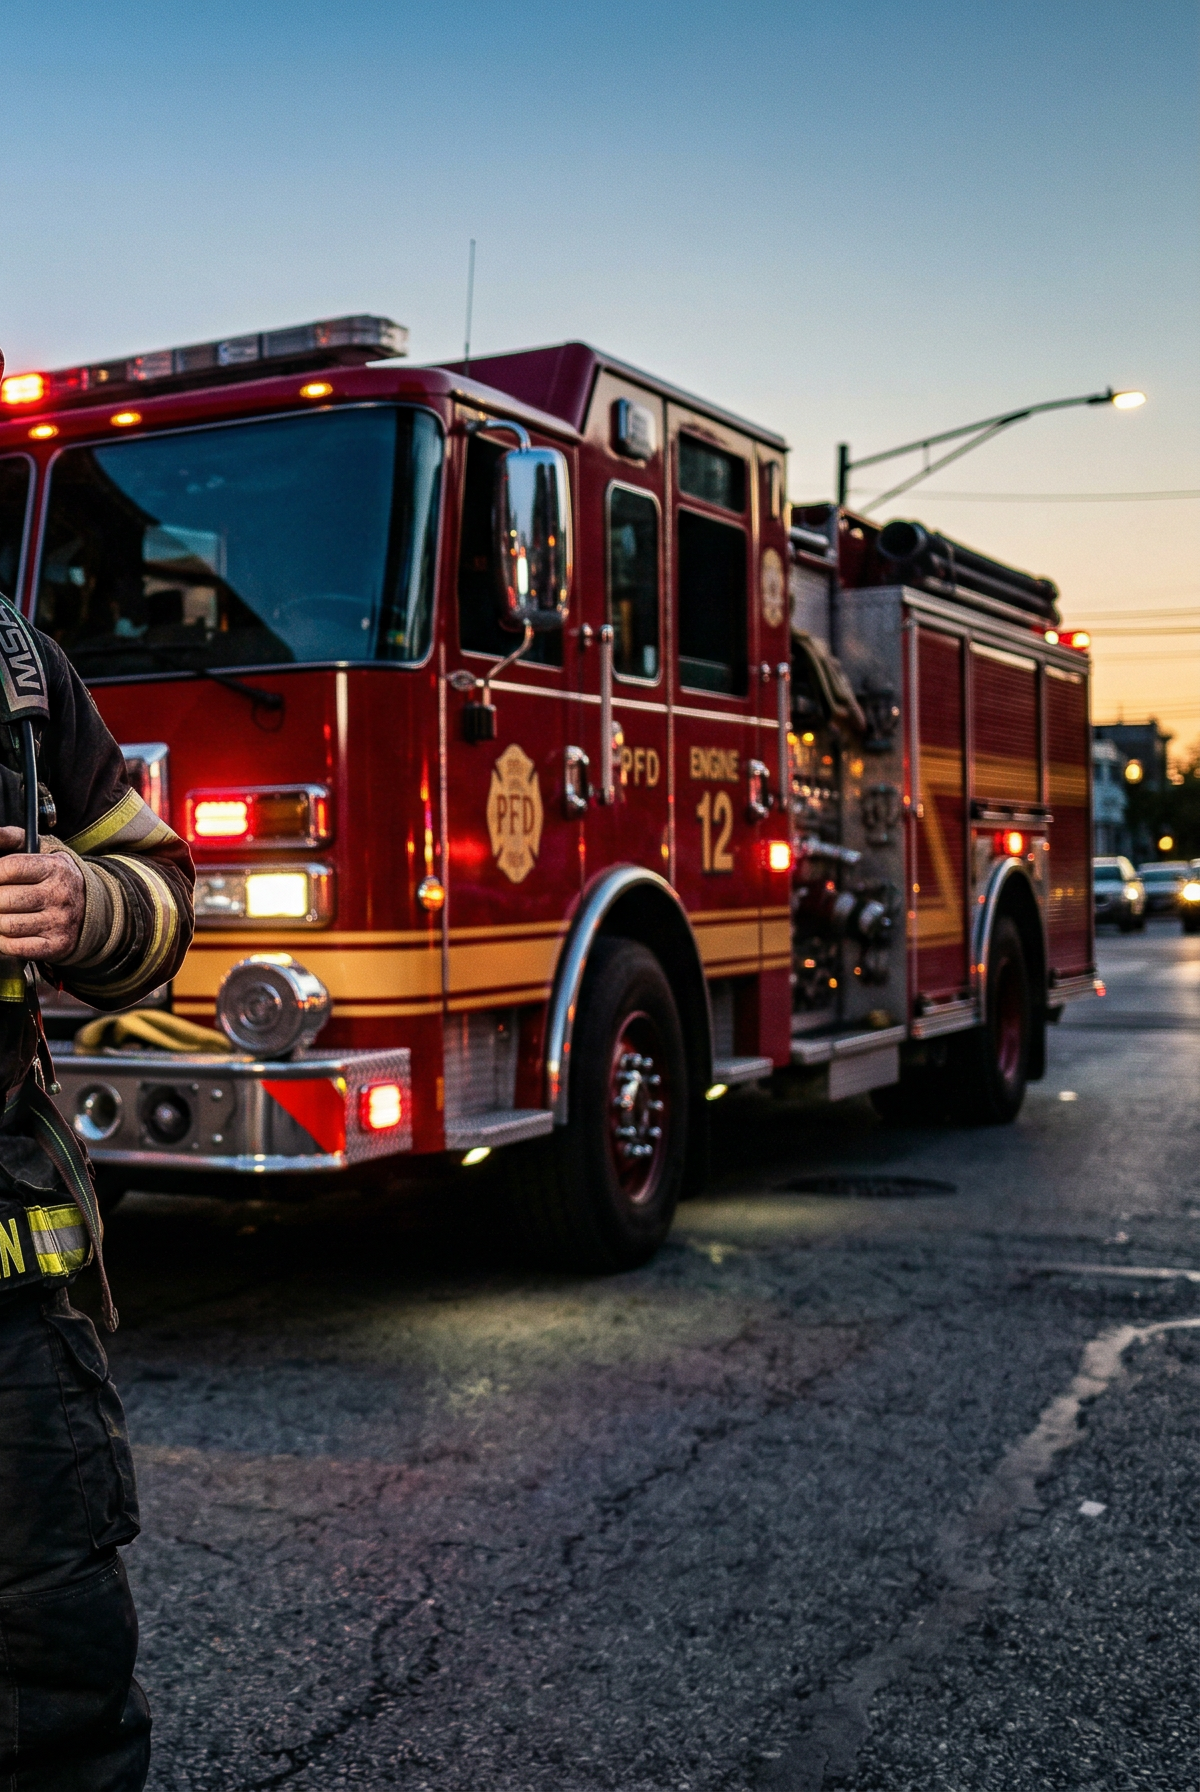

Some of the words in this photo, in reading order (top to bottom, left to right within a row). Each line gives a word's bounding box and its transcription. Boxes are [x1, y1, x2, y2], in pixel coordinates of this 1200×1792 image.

[620, 745, 661, 788] PFD
[496, 793, 536, 836] PFD
[696, 789, 734, 873] 12
